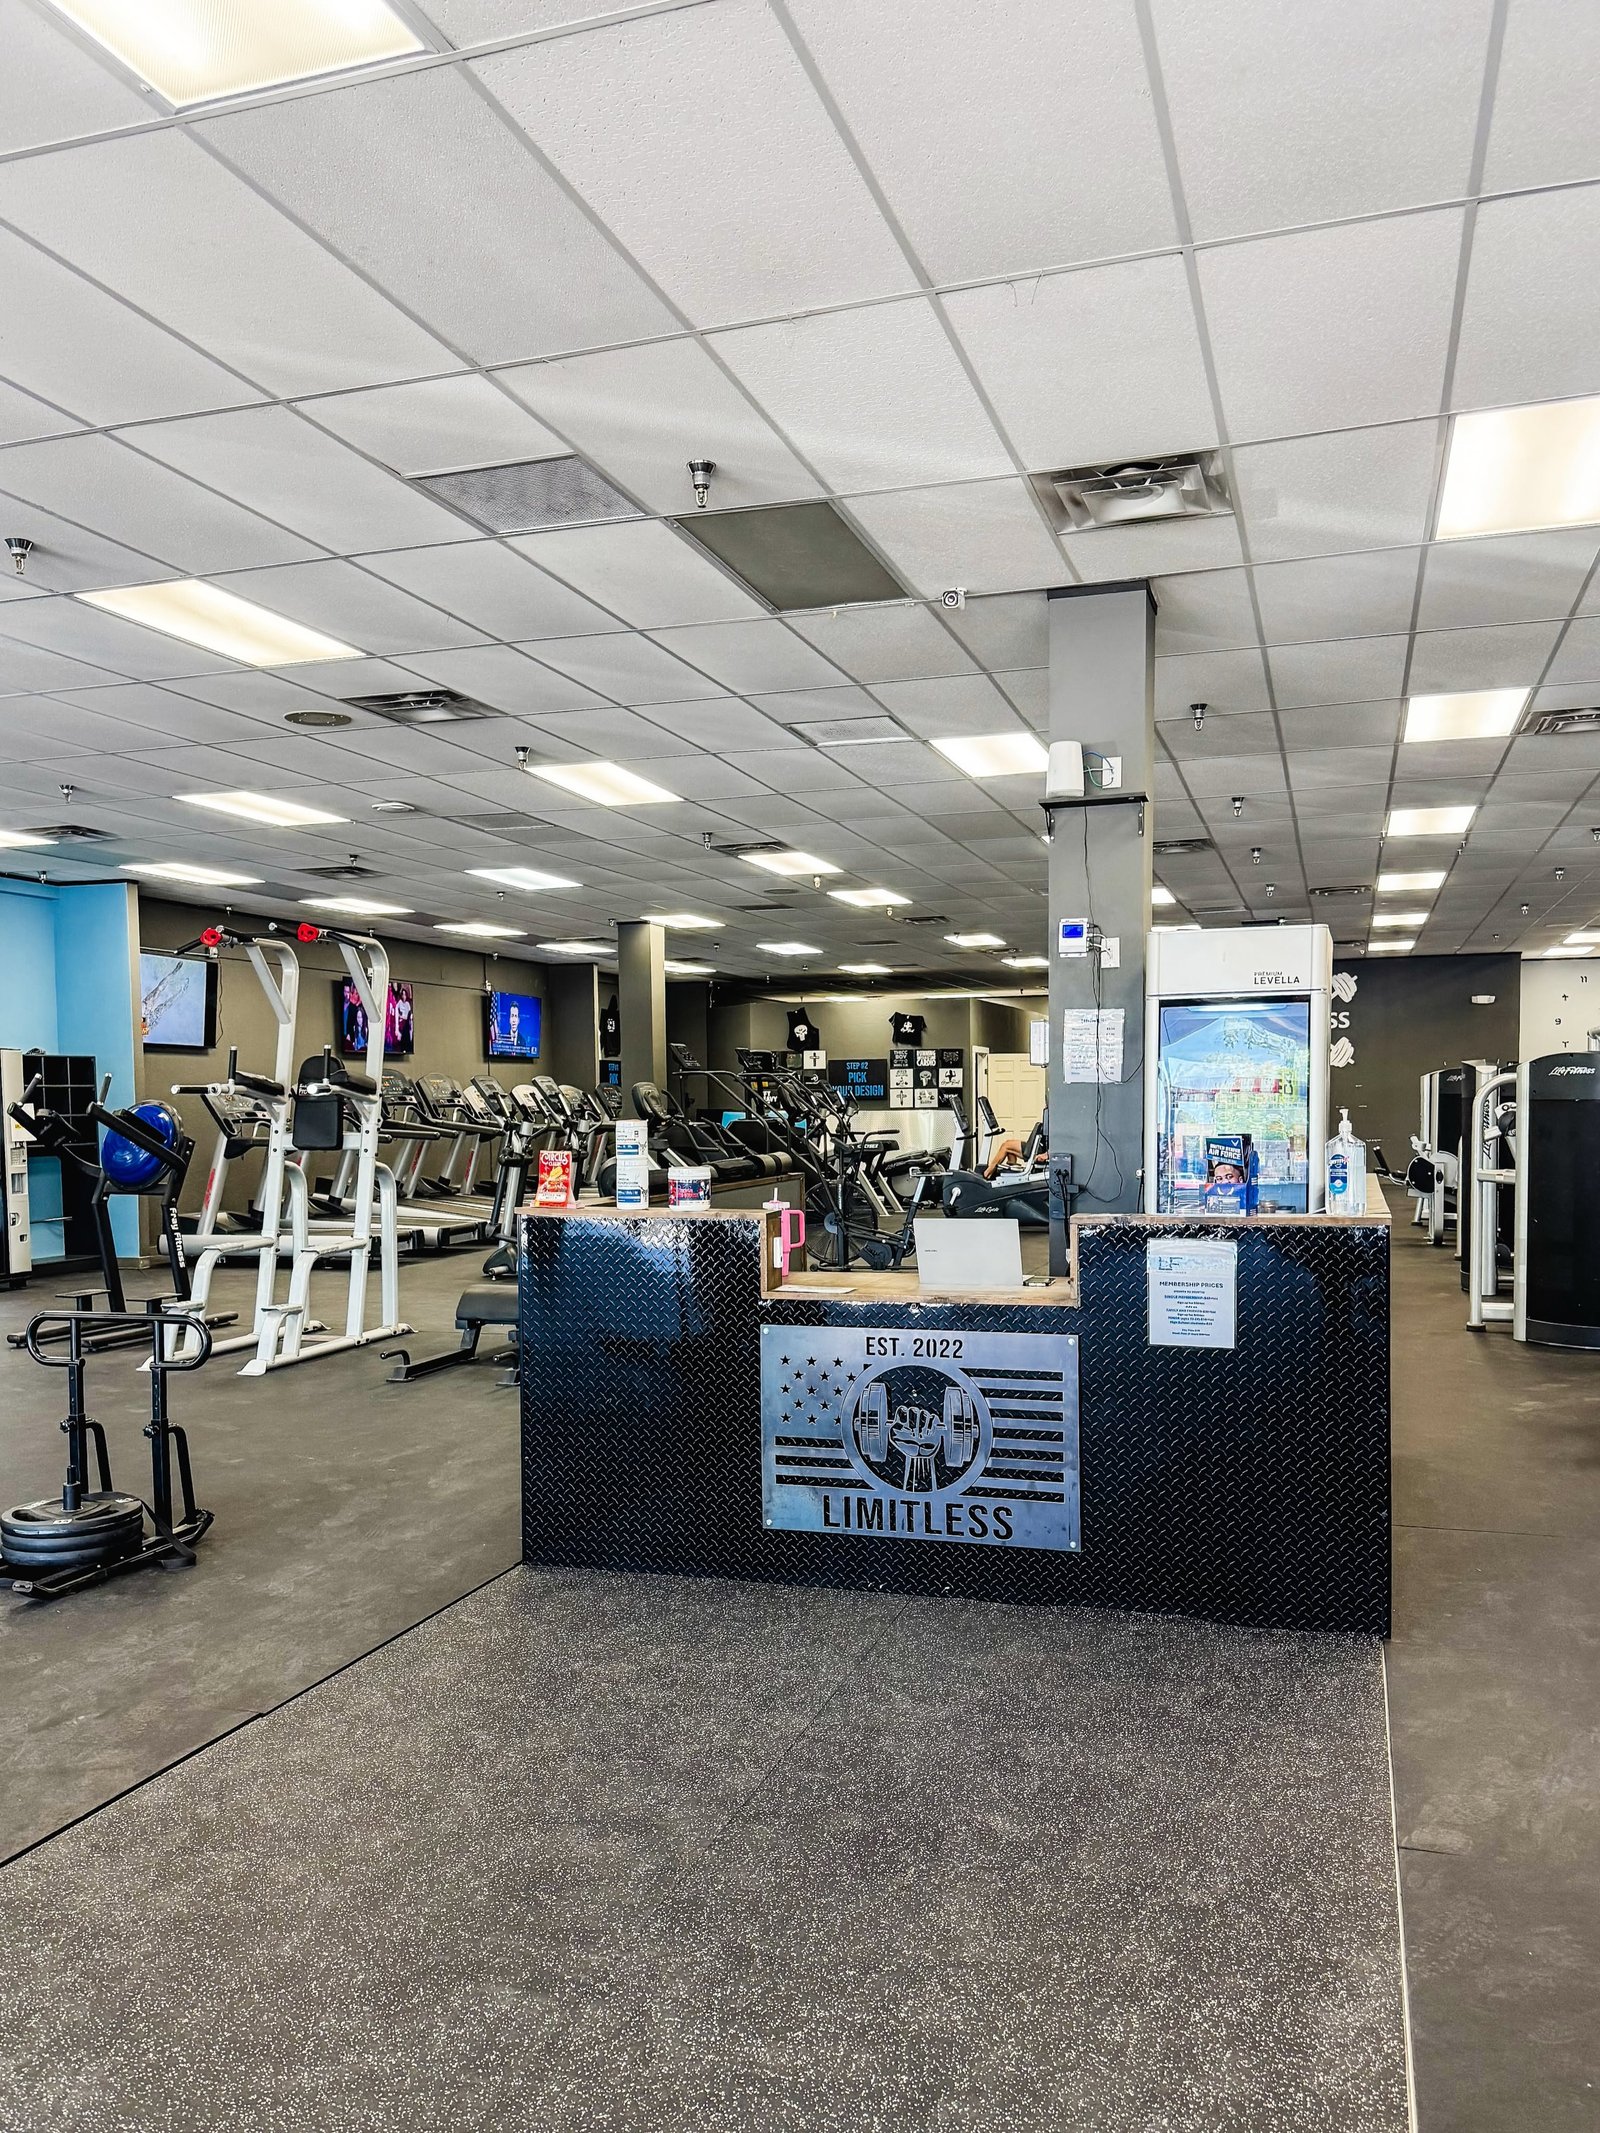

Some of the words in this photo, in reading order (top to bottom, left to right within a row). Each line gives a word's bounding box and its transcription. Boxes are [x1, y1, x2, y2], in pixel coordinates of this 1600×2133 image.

[1253, 976, 1300, 985] LEVELLA
[846, 1062, 860, 1070] STEP
[848, 1071, 867, 1083] PICK
[854, 1085, 884, 1096] DESIGN
[541, 1152, 569, 1166] CIRCUS
[1208, 1148, 1219, 1156] AIR
[1220, 1150, 1241, 1160] FORCE
[169, 1207, 179, 1230] Fray
[173, 1231, 186, 1268] Fitness
[865, 1336, 905, 1357] EST.
[913, 1337, 963, 1359] 2022
[823, 1494, 1013, 1540] LIMITLESS
